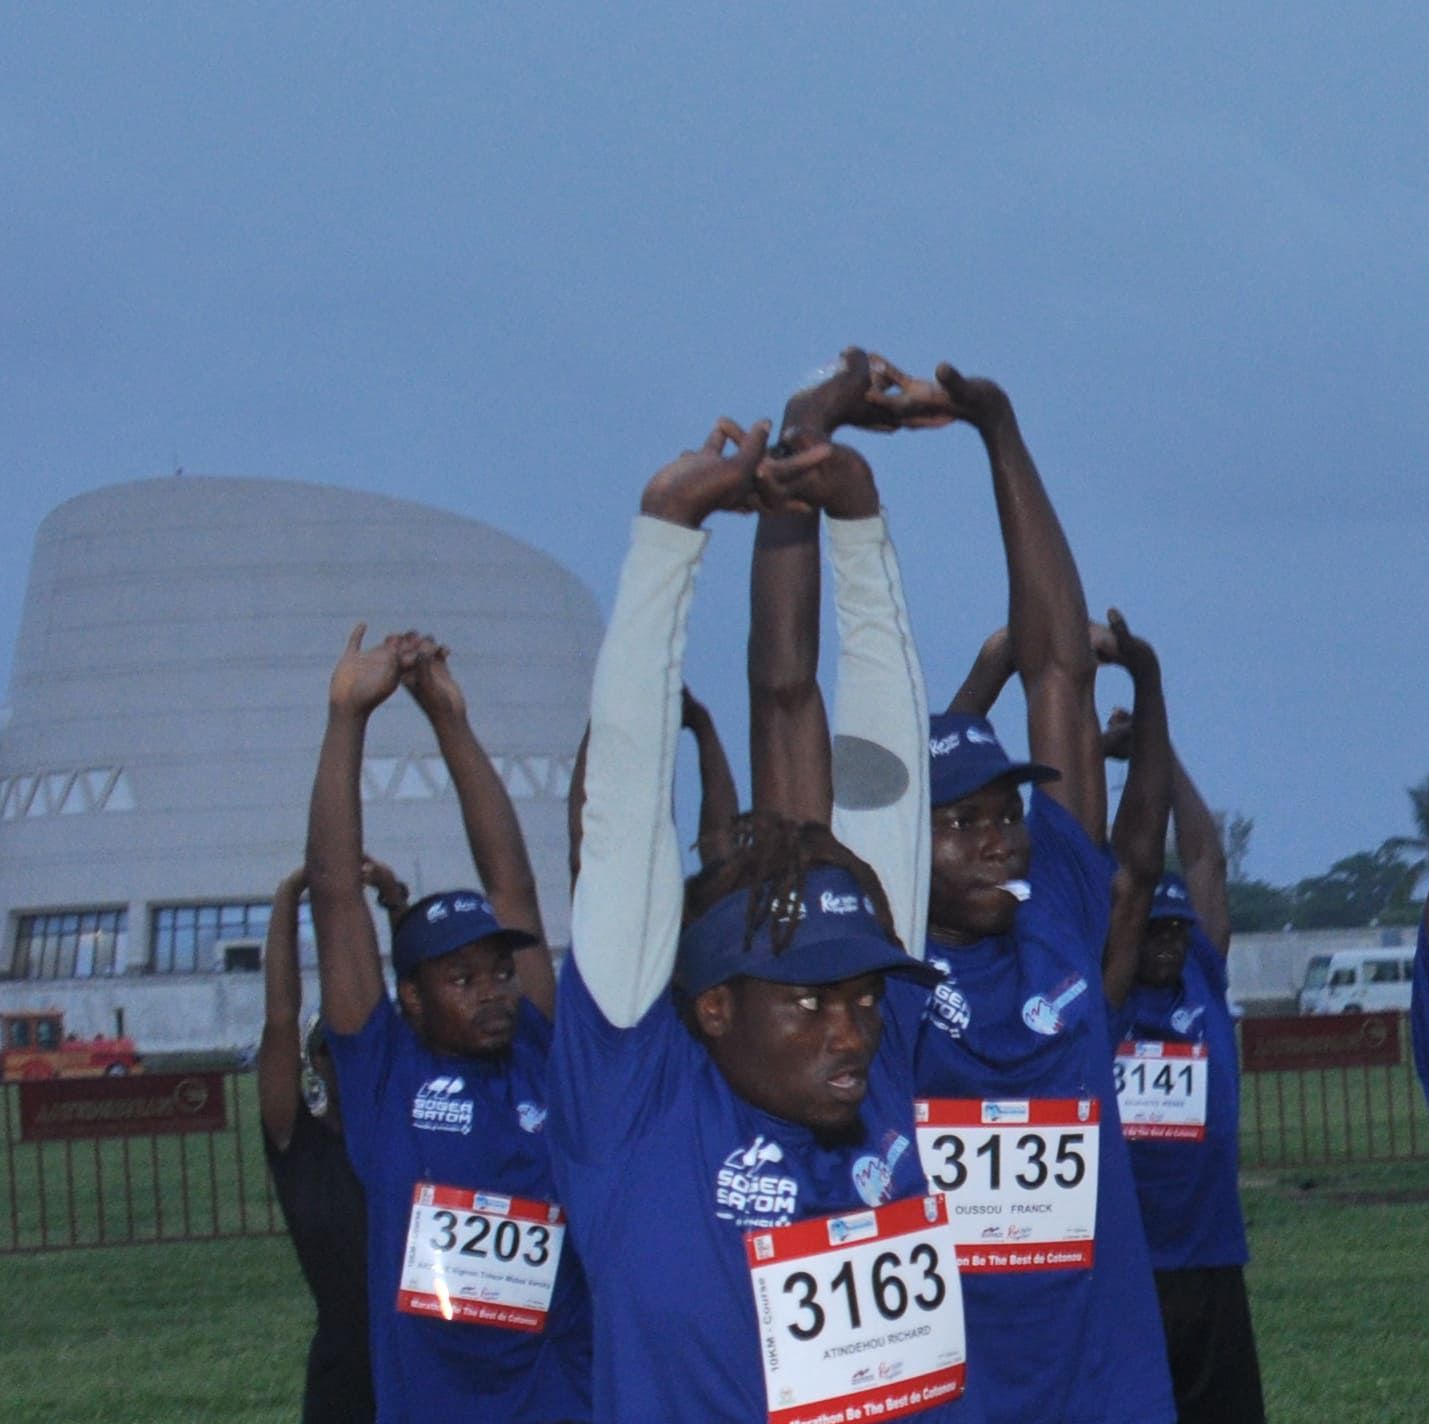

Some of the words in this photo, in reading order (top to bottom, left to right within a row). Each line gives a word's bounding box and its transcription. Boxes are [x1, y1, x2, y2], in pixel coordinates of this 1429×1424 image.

[1113, 1063, 1194, 1097] 3141
[412, 1109, 473, 1124] SATOM
[413, 1099, 474, 1114] SOGEA
[931, 1132, 1086, 1192] 3135
[1011, 1204, 1053, 1214] FRANCK
[430, 1210, 549, 1267] 3203
[971, 1255, 986, 1266] Be
[988, 1254, 1007, 1266] The
[1009, 1253, 1032, 1266] Best
[1033, 1253, 1045, 1264] de
[782, 1242, 946, 1341] 3163
[766, 1336, 780, 1372] 10KM
[823, 1337, 886, 1360] ATINDEHOU
[887, 1325, 932, 1345] RICHARD
[845, 1406, 862, 1421] Be
[863, 1402, 884, 1417] The
[885, 1394, 909, 1411] Best
[909, 1391, 922, 1404] de
